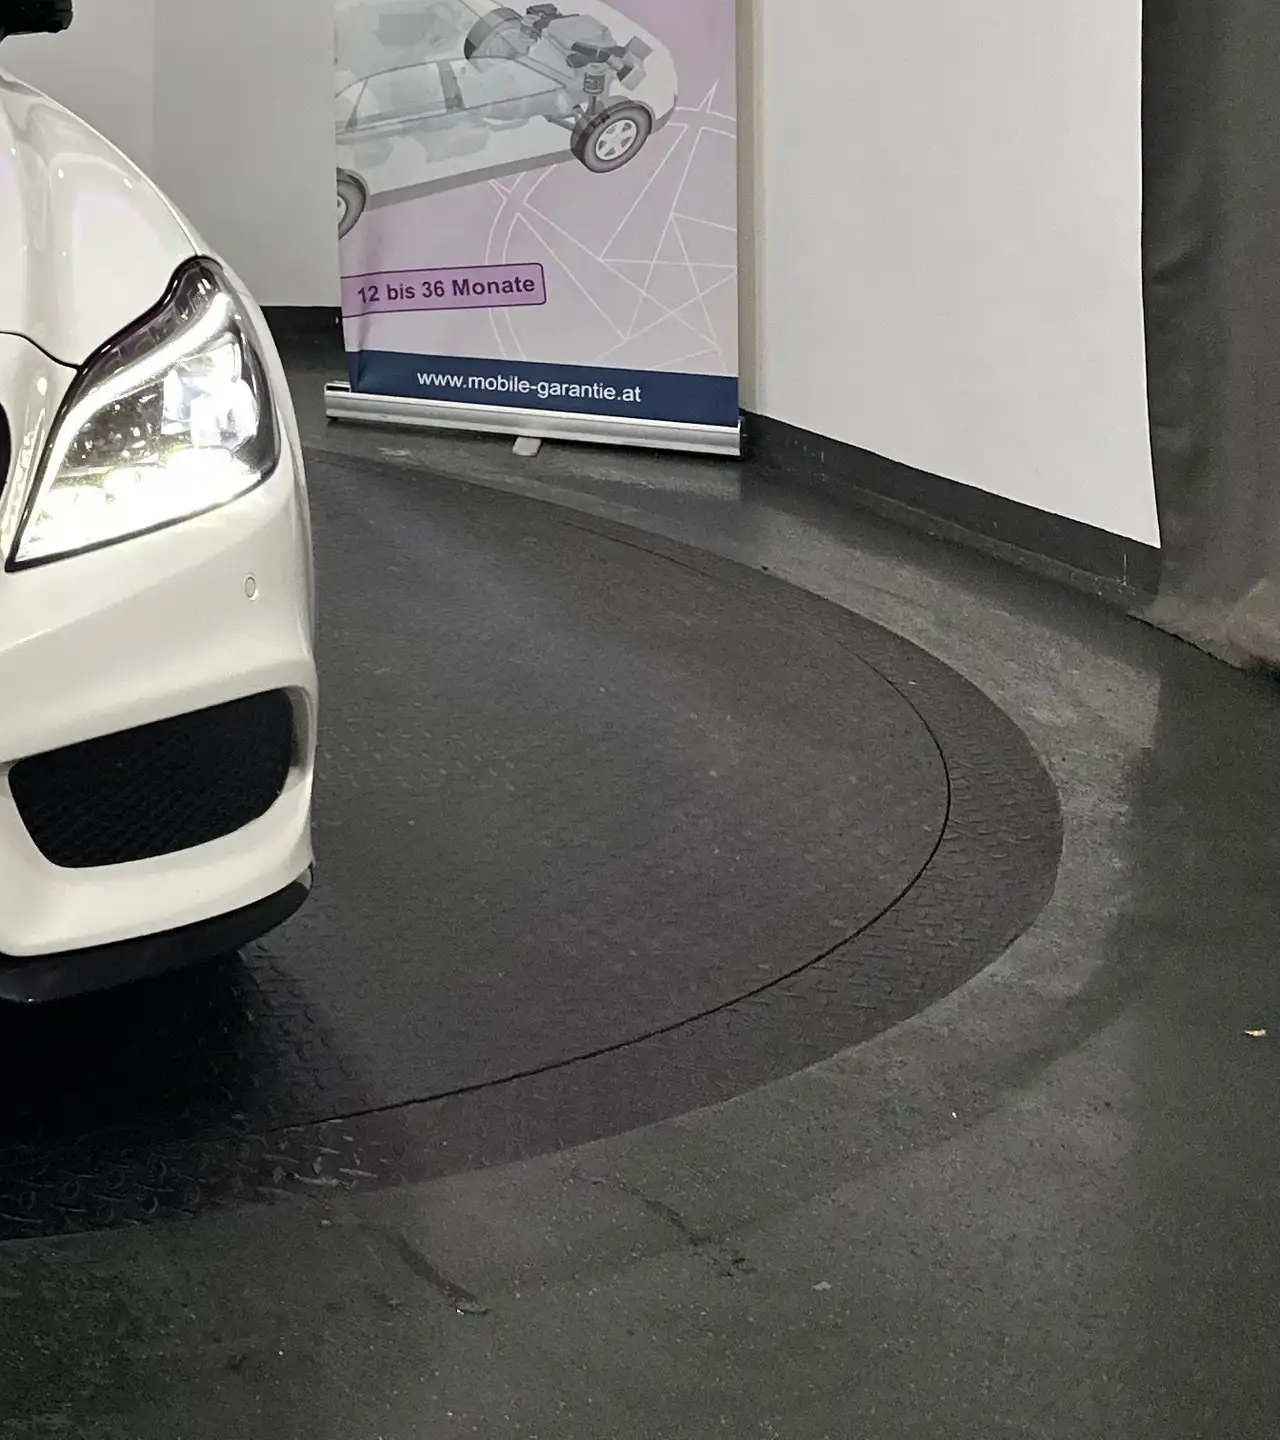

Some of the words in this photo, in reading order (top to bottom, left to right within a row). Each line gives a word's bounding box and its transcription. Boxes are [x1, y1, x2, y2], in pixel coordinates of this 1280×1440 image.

[357, 284, 381, 306] 12
[386, 282, 416, 301] bis
[421, 279, 445, 299] 36
[451, 275, 536, 297] Monate
[416, 372, 641, 403] www.mobile-garantie.at
